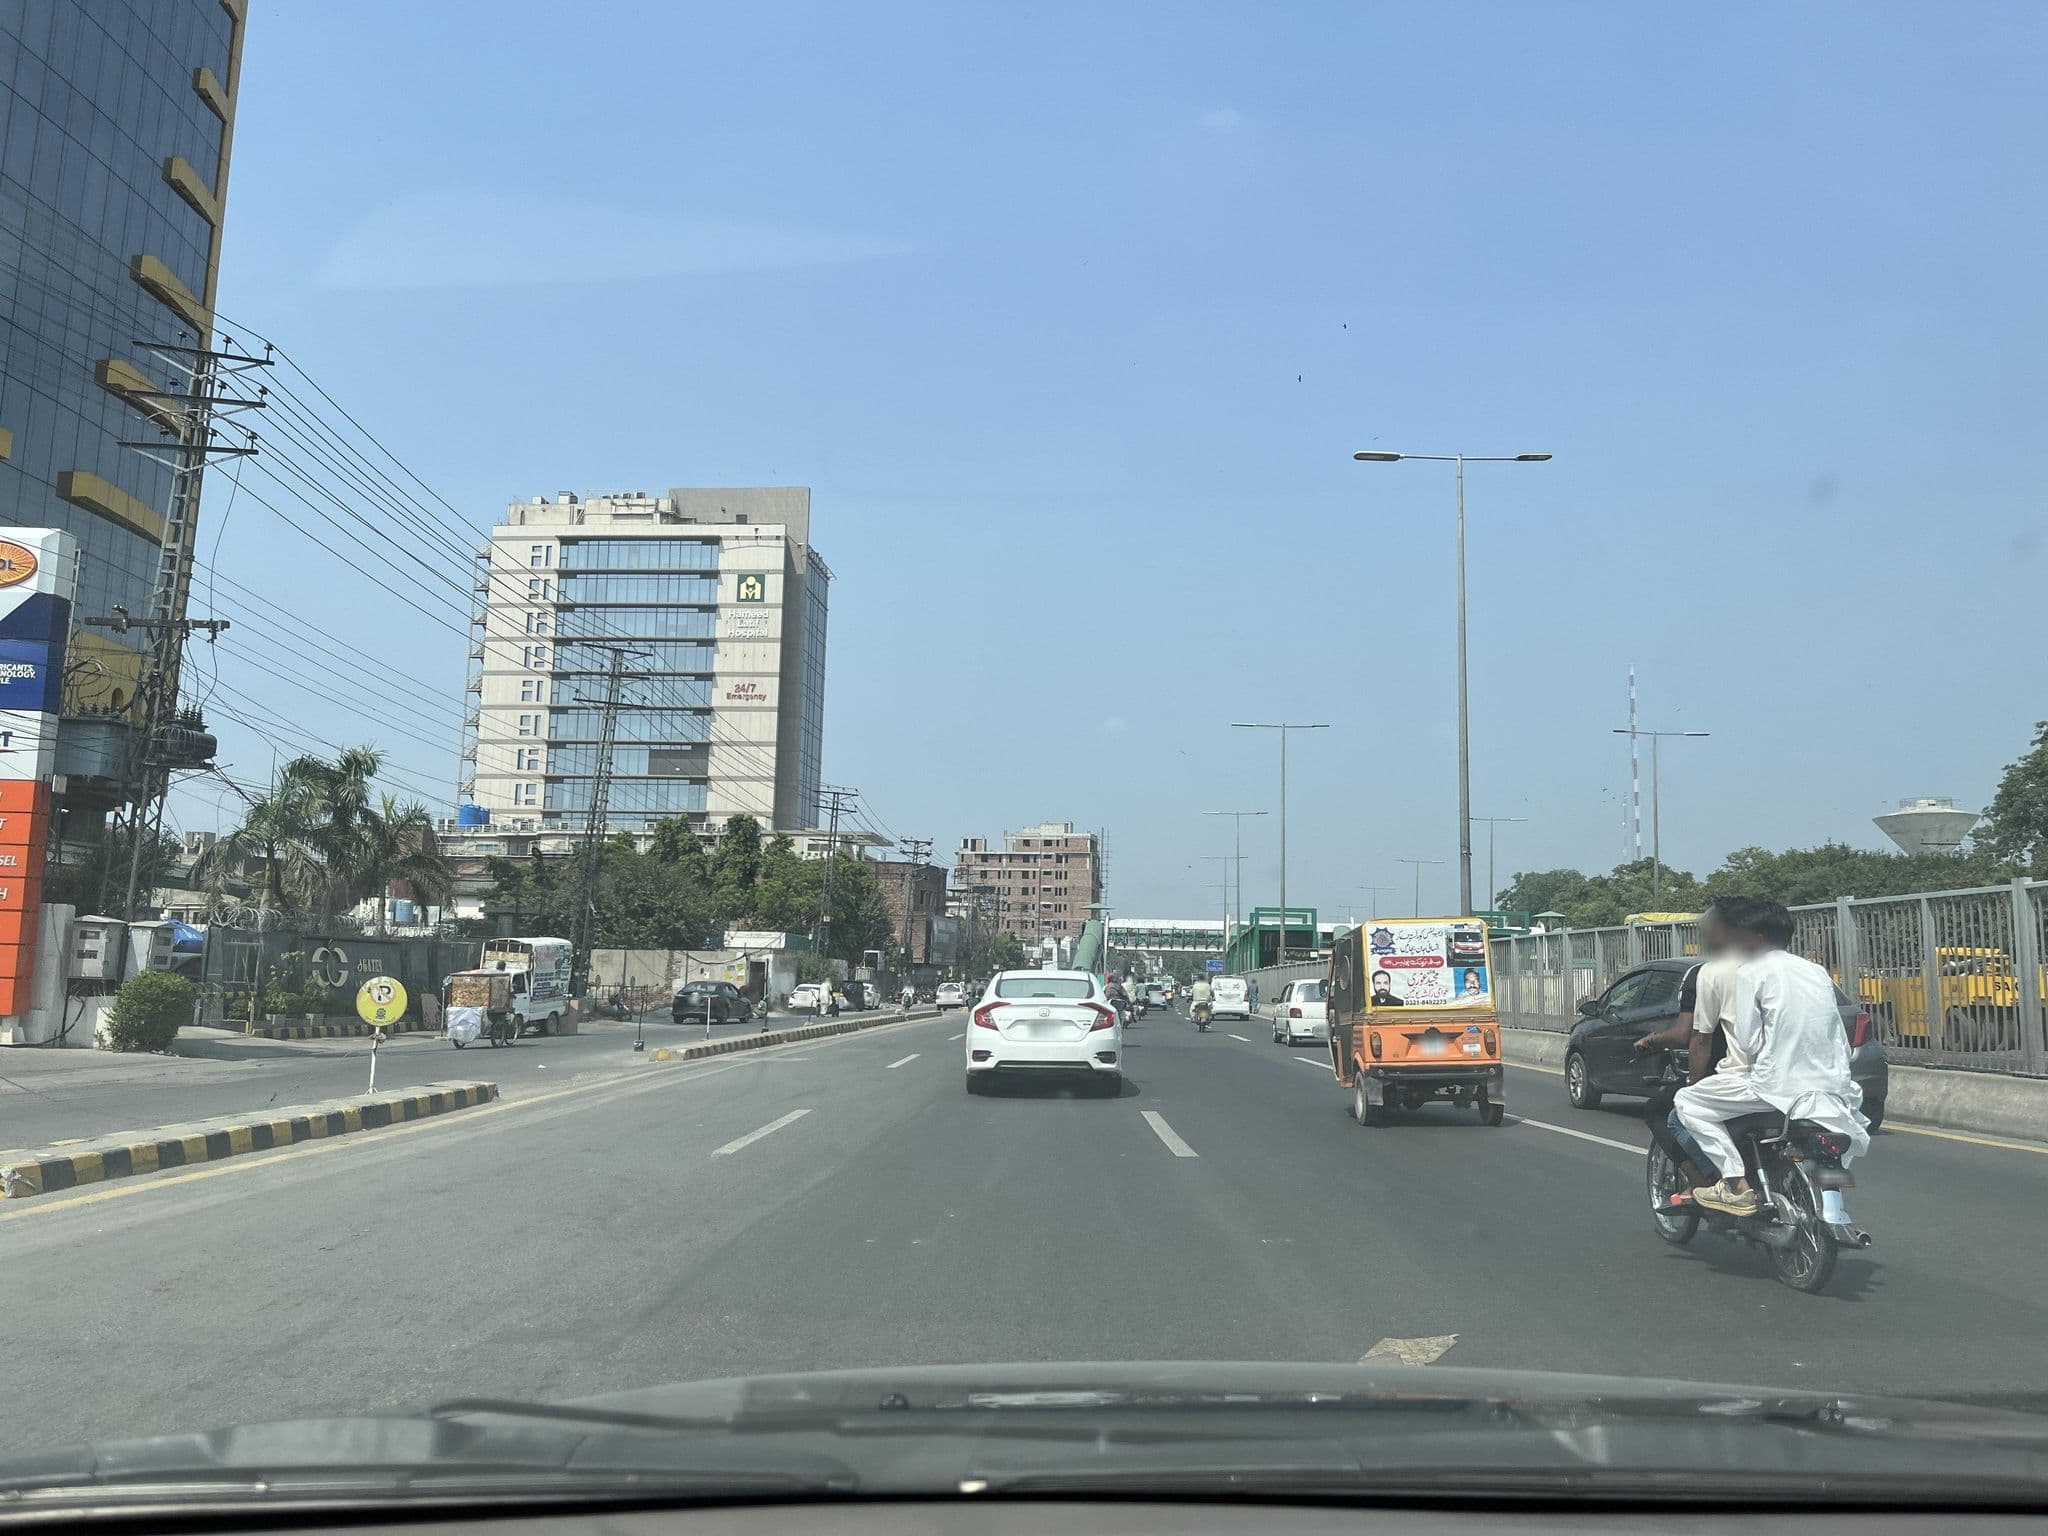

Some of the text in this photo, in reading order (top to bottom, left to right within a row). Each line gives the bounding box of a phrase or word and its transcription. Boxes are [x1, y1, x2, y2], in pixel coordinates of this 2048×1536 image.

[729, 609, 769, 619] Hameed
[728, 629, 768, 639] Hospital
[734, 684, 757, 693] 24/7
[727, 693, 767, 702] Emergency
